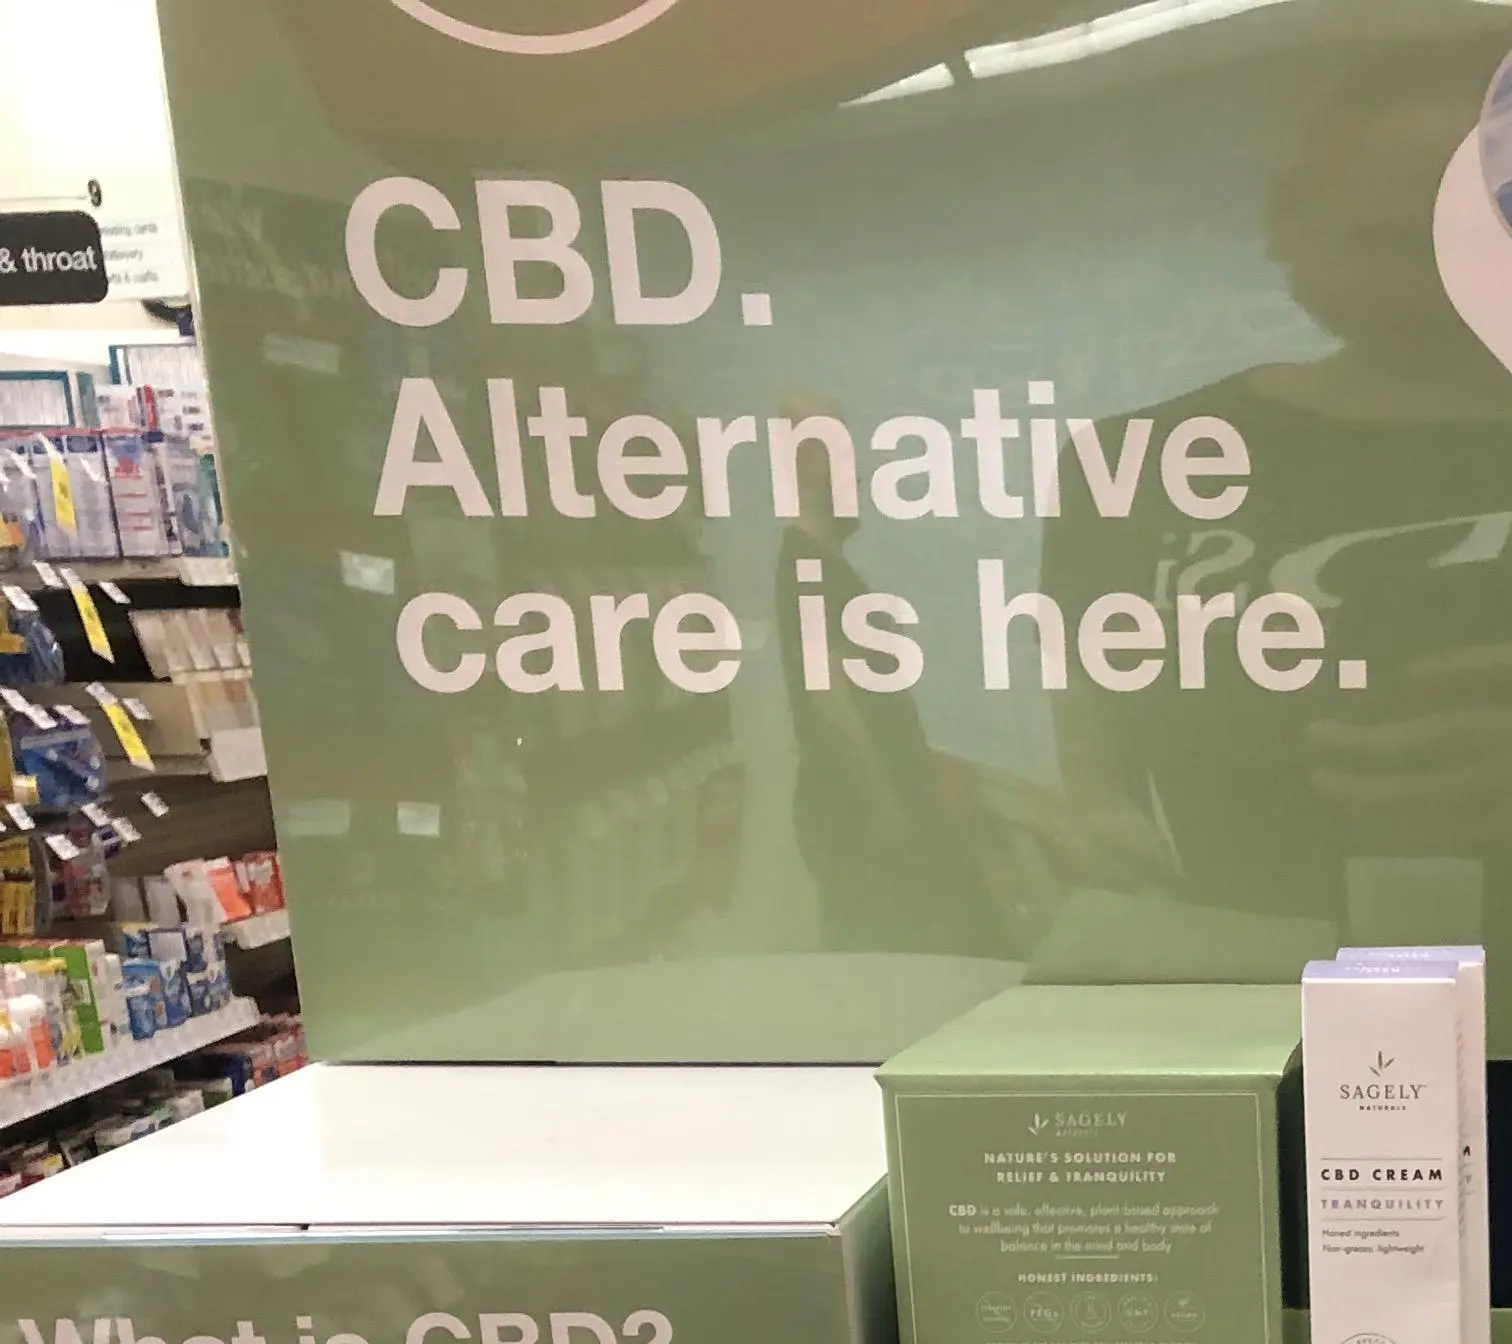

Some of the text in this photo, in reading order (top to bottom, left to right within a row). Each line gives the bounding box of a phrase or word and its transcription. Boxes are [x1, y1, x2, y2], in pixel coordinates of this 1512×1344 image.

[88, 179, 102, 207] 9
[0, 248, 17, 273] &
[21, 246, 98, 272] throat
[344, 177, 772, 327] CBD.
[373, 378, 1251, 521] Alternative
[396, 559, 1367, 694] care is here.
[1340, 1083, 1422, 1101] SAGELY
[1054, 1111, 1128, 1128] SAGELY
[984, 1152, 1176, 1164] NATURE'S SOLUTION FOR
[997, 1171, 1166, 1183] RELIEF & TRANQUILITY
[1321, 1168, 1443, 1182] CBD CREAM
[949, 1205, 977, 1216] CBD
[1321, 1199, 1444, 1211] TRANQUILITY
